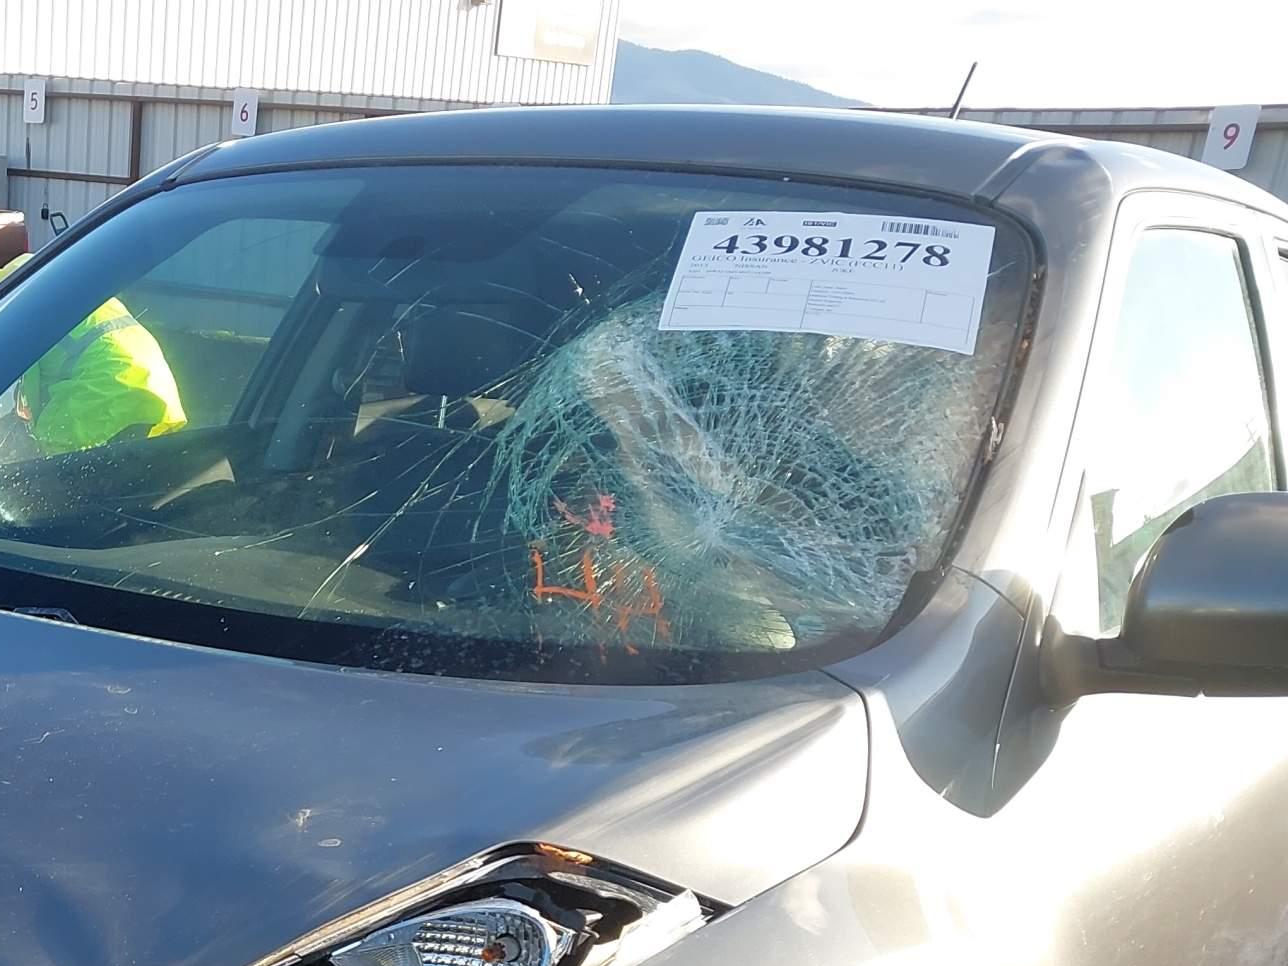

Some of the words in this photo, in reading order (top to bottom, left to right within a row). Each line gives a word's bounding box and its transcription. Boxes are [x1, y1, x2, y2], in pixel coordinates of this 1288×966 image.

[30, 92, 38, 110] 5
[240, 103, 249, 122] 6
[1223, 123, 1241, 150] 9
[691, 254, 737, 262] GEICO
[712, 233, 952, 268] 43981278
